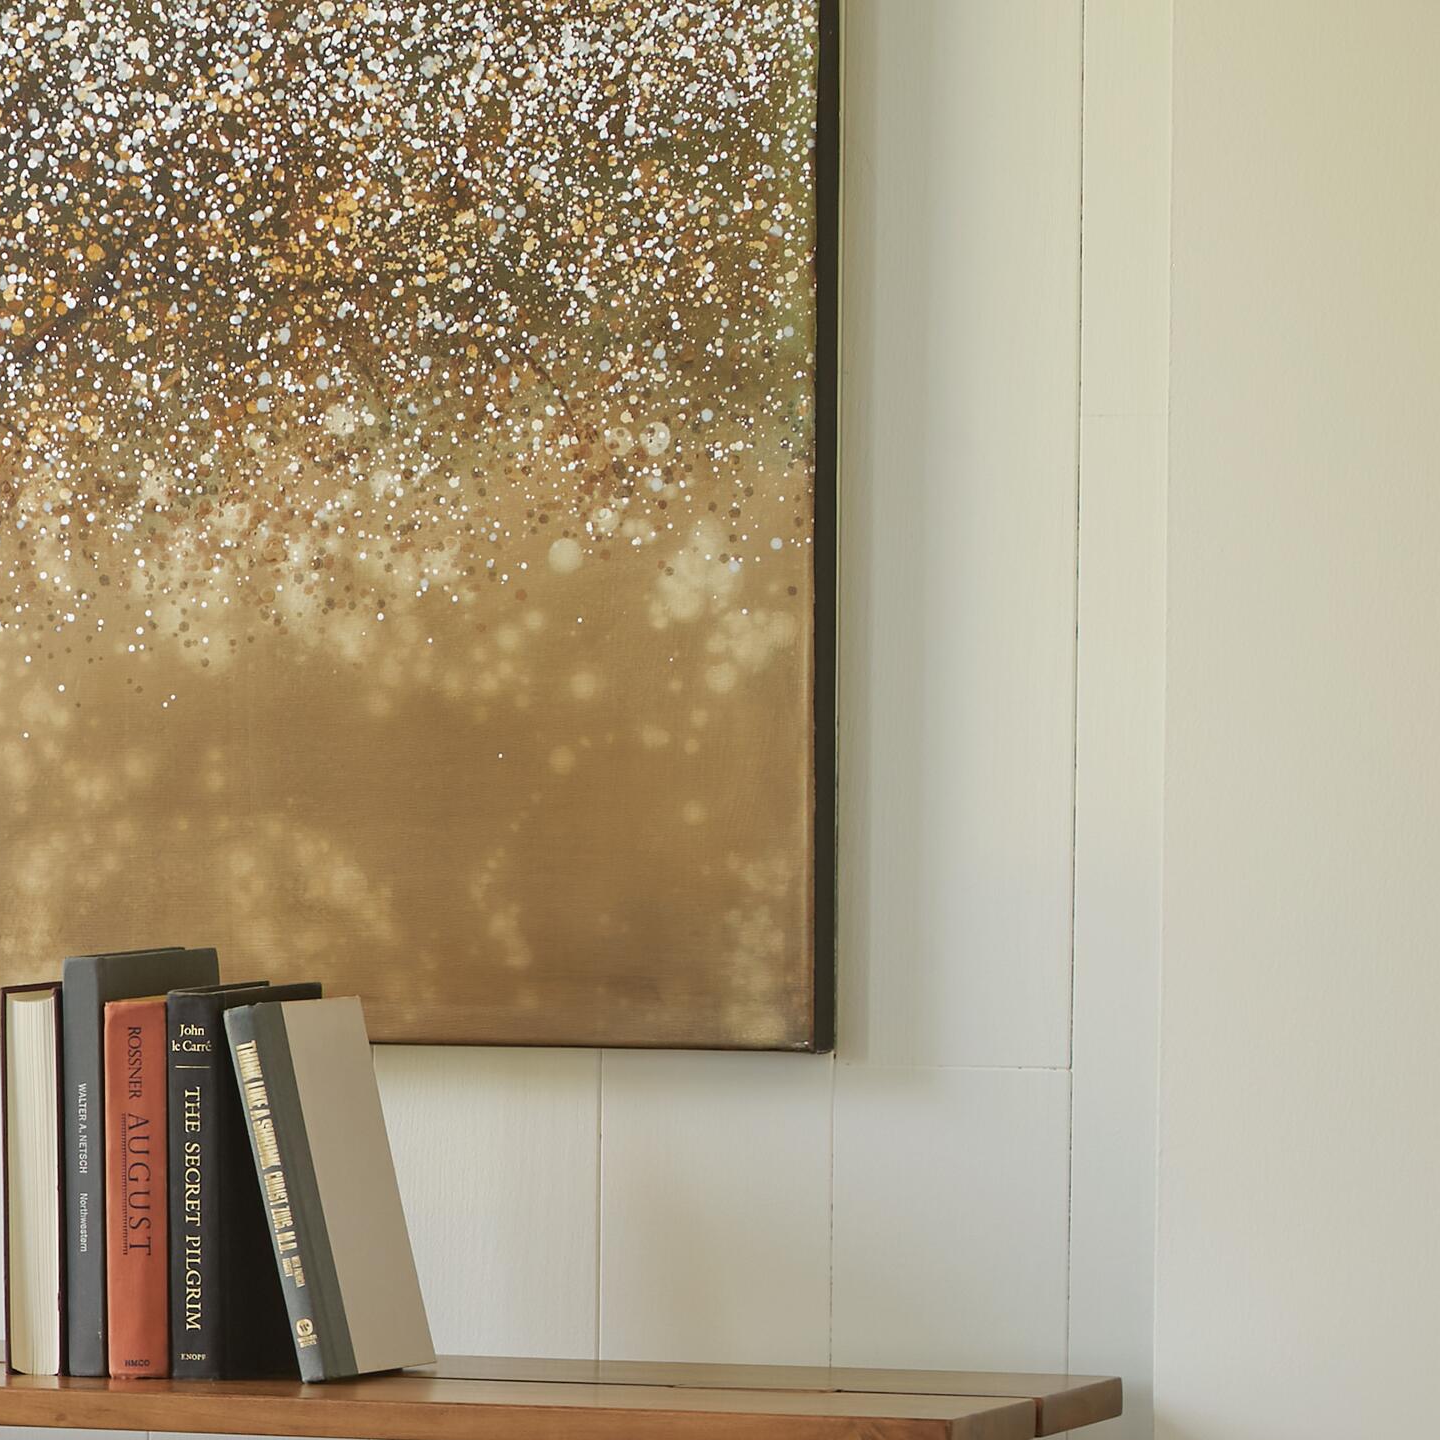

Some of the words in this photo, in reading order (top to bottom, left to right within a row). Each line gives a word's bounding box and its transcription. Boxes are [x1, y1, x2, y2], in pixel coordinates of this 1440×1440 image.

[172, 1040, 181, 1052] le
[183, 1040, 212, 1052] Carré
[179, 1024, 205, 1037] John
[128, 1026, 142, 1099] ROSSNER
[236, 1040, 263, 1083] THINK
[78, 1083, 88, 1121] WALTER
[185, 1086, 201, 1133] THE
[244, 1080, 269, 1109] LIKE
[78, 1123, 88, 1134] A.
[250, 1108, 271, 1121] A
[79, 1135, 88, 1174] NETSCH
[252, 1118, 281, 1170] SHRINK
[128, 1113, 151, 1256] AUGUST
[185, 1142, 201, 1226] SECRET
[264, 1171, 289, 1206] CHRIST
[80, 1192, 89, 1252] Northwestern
[185, 1235, 201, 1331] PILGRIM
[180, 1353, 206, 1361] KNOPF
